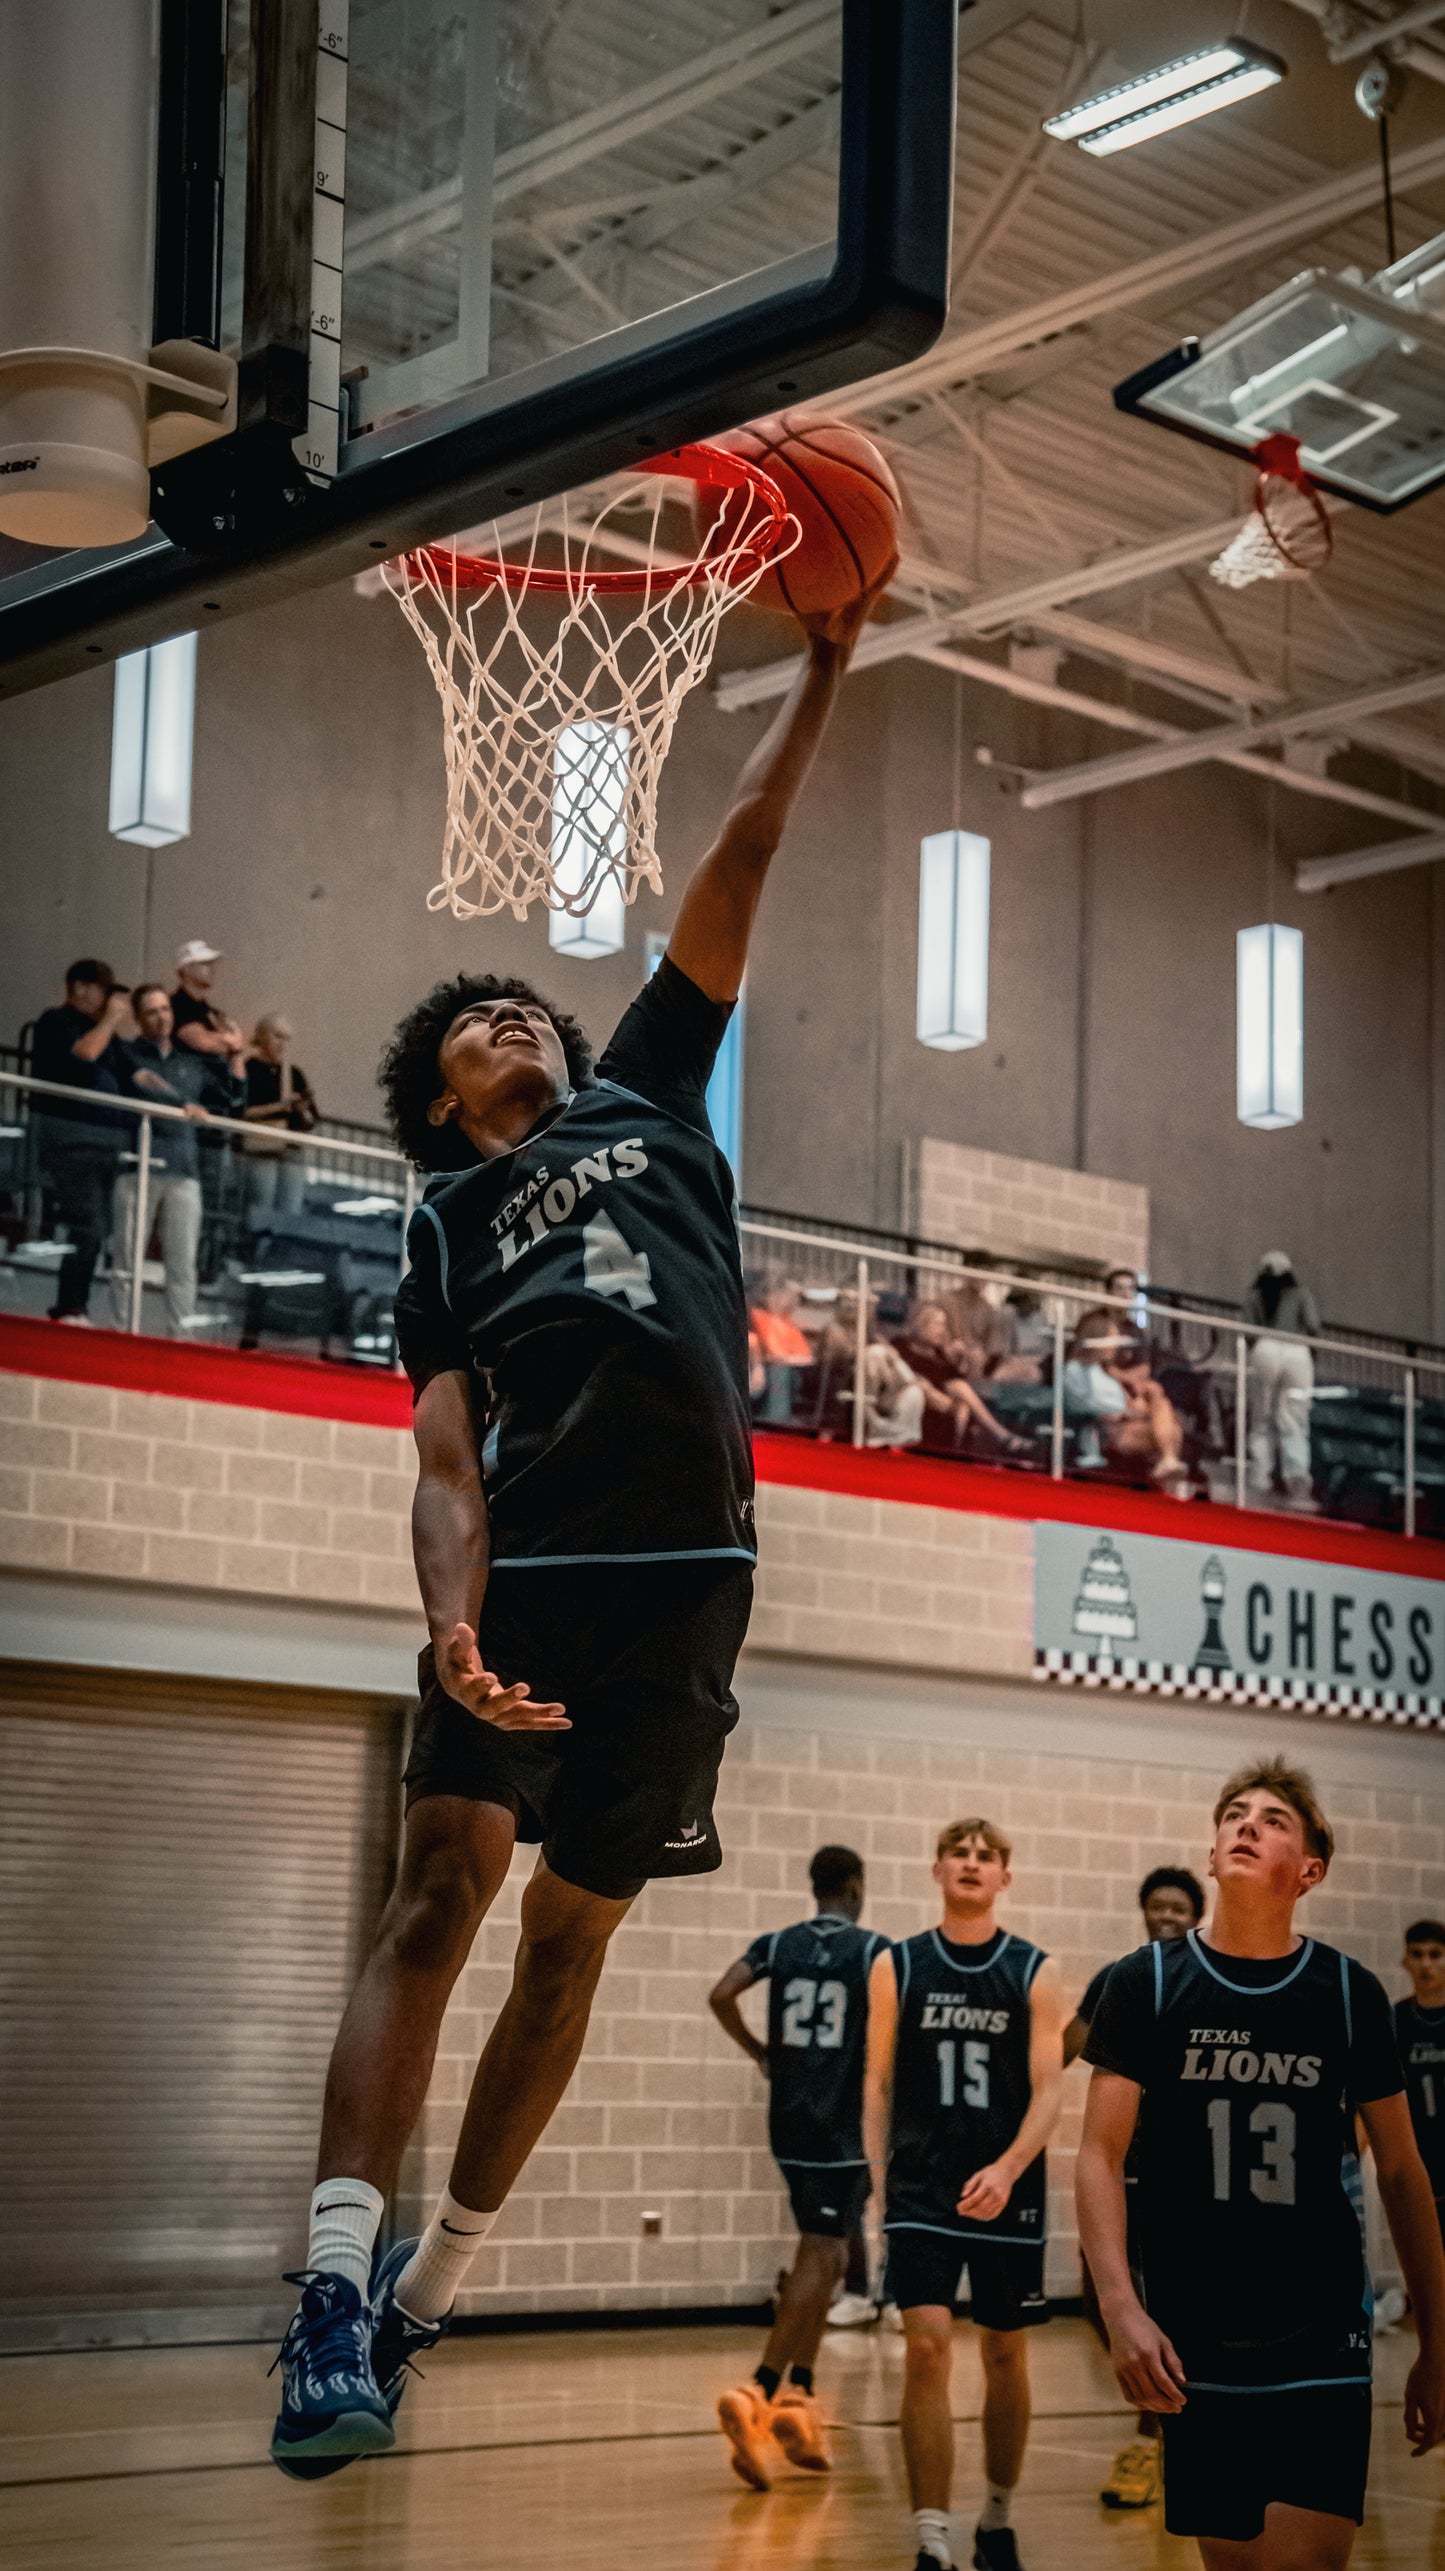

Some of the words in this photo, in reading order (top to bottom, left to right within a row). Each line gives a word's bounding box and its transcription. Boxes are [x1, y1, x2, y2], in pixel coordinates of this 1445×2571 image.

[317, 171, 328, 187] 9'
[306, 450, 325, 468] 10'
[490, 1166, 549, 1236] TEXAS
[497, 1138, 649, 1273] LIONS
[582, 1208, 658, 1311] 4
[1247, 1581, 1432, 1686] CHESS
[782, 1977, 848, 2049] 23
[920, 2006, 1010, 2034] LIONS
[1189, 2029, 1251, 2045] TEXAS
[937, 2040, 990, 2109] 15
[1180, 2048, 1323, 2088] LIONS
[1207, 2098, 1297, 2206] 13
